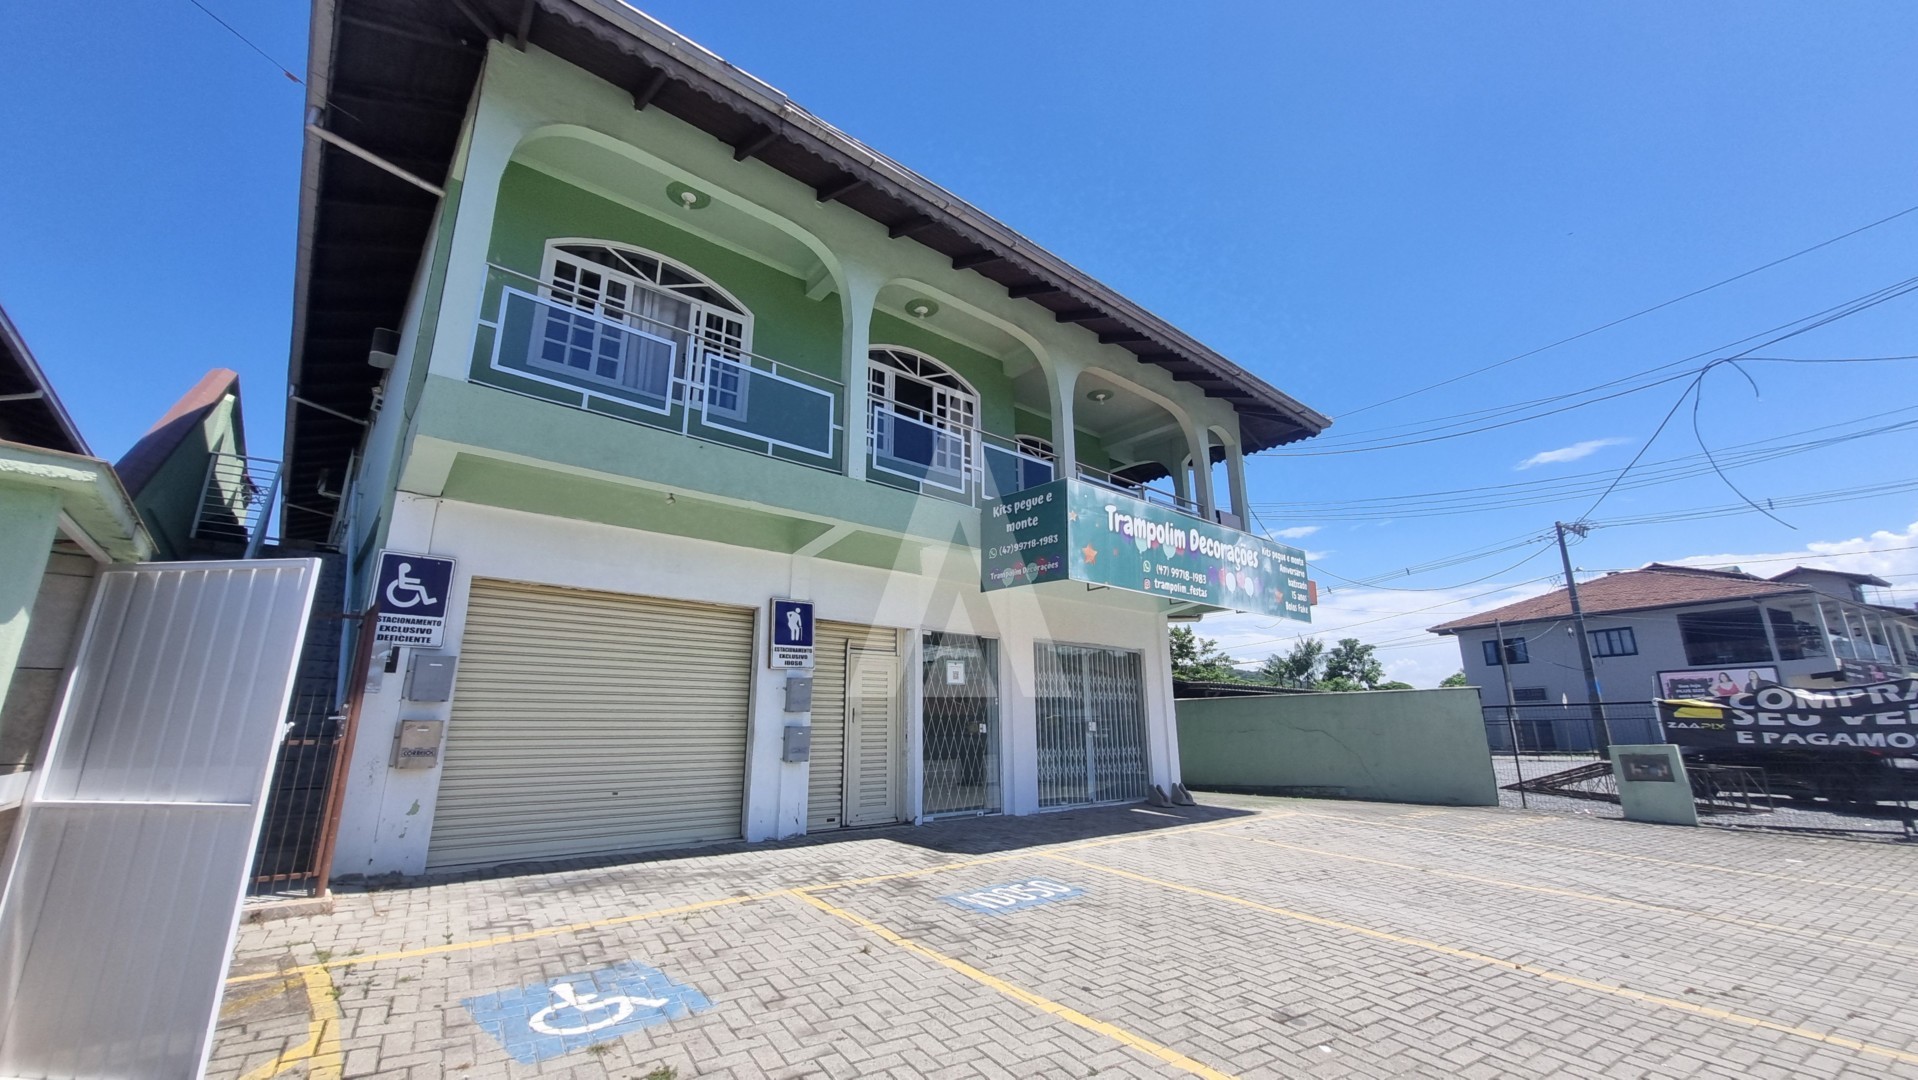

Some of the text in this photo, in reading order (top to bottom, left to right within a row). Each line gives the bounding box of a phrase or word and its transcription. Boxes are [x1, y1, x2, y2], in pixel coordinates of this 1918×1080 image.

[993, 492, 1053, 518] Kits pegue e
[1006, 516, 1039, 533] monte
[999, 534, 1059, 556] (47)99718-1983
[1105, 504, 1259, 571] Trampolim Decorações
[1156, 564, 1207, 585] (47) 99718-1983
[1154, 578, 1208, 598] trampolim_festas
[377, 615, 442, 627] STACIONAMENTO
[379, 625, 433, 635] EXCLUSIVO
[376, 634, 432, 644] DEFICIENTE
[774, 646, 813, 654] ESTACIONAMENTO
[1666, 721, 1726, 730] ZAAPIX
[1736, 731, 1918, 749] E PAGAMO
